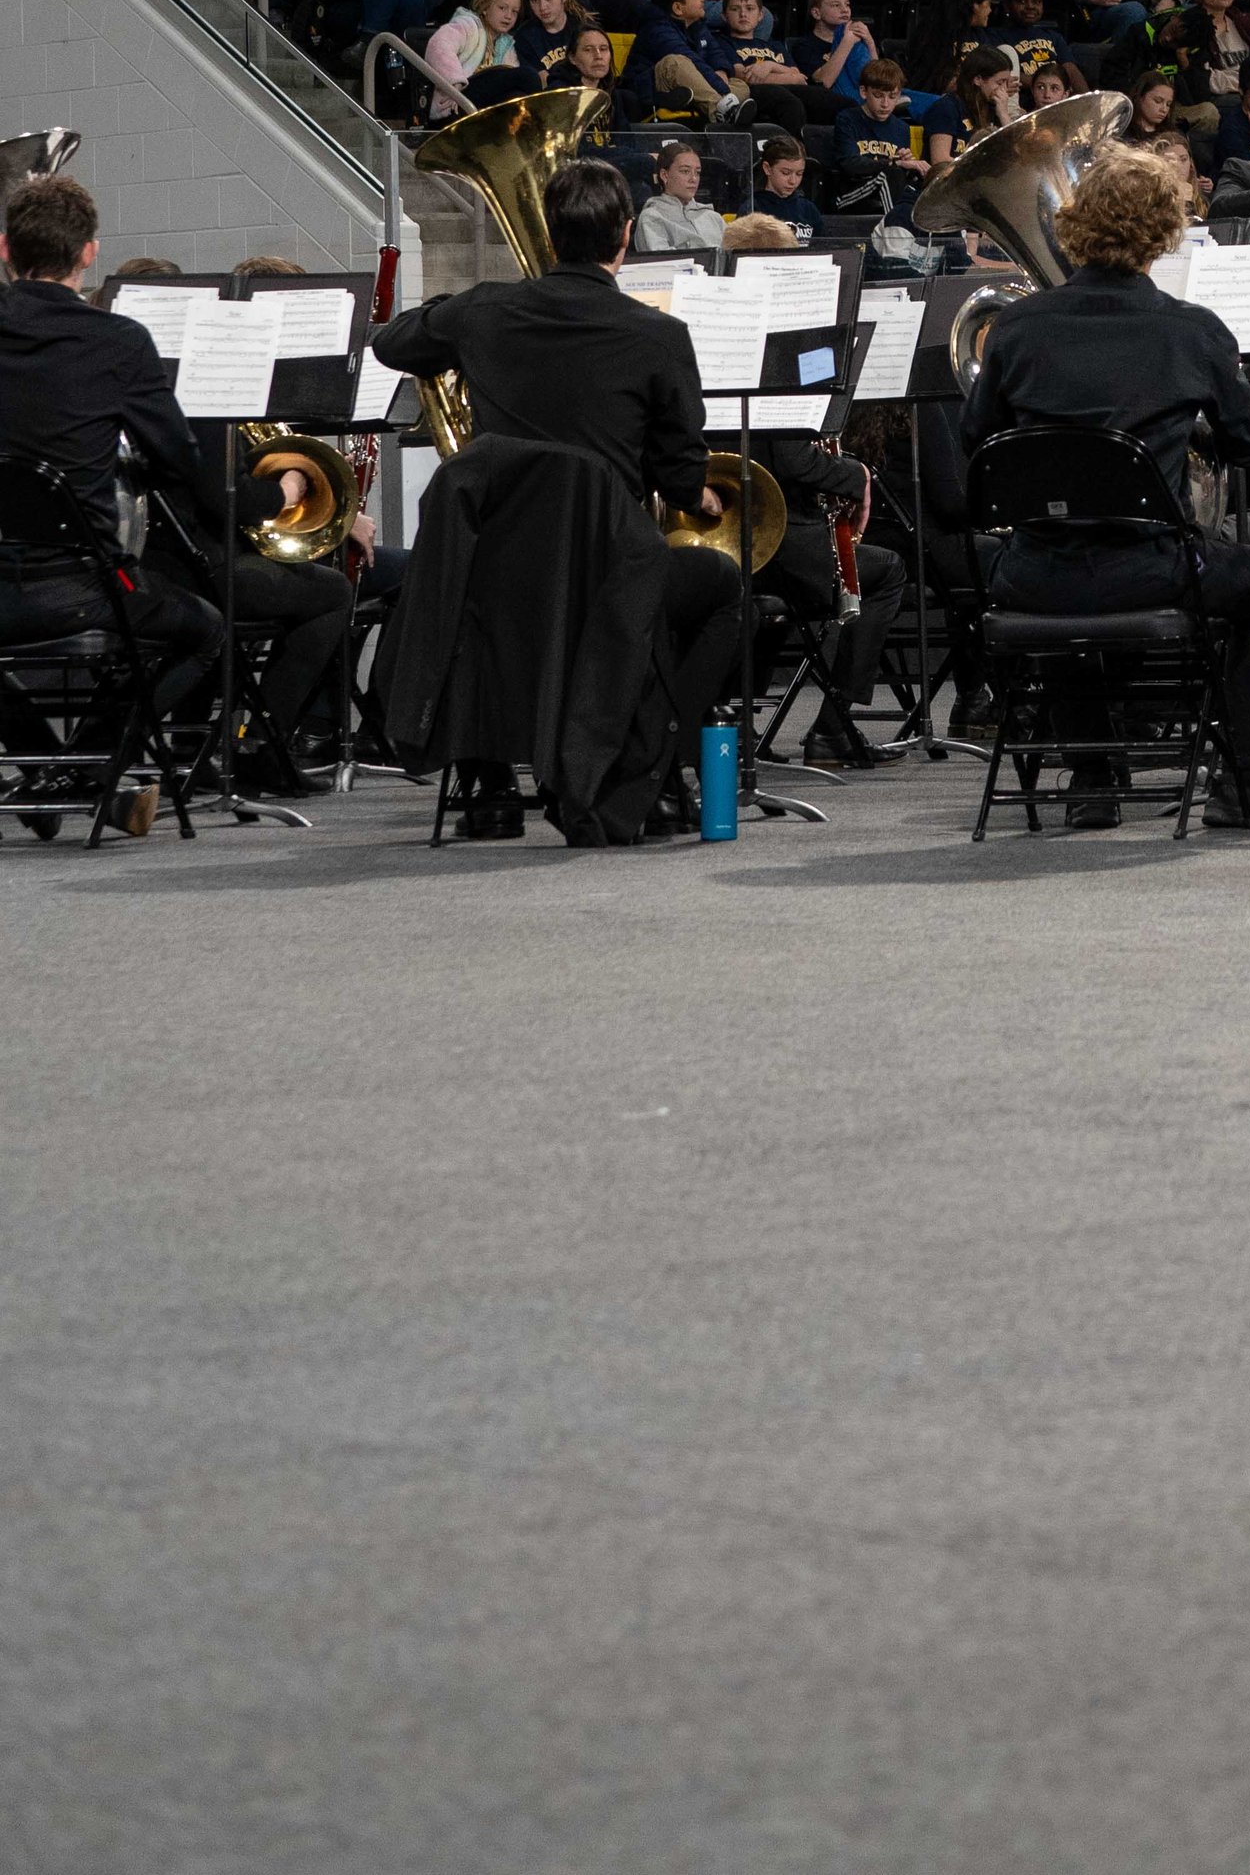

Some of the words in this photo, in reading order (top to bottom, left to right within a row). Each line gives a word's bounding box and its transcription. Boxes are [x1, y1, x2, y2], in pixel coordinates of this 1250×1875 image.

[1014, 37, 1056, 55] REGIN
[540, 45, 568, 70] REG
[857, 140, 900, 158] EGIN
